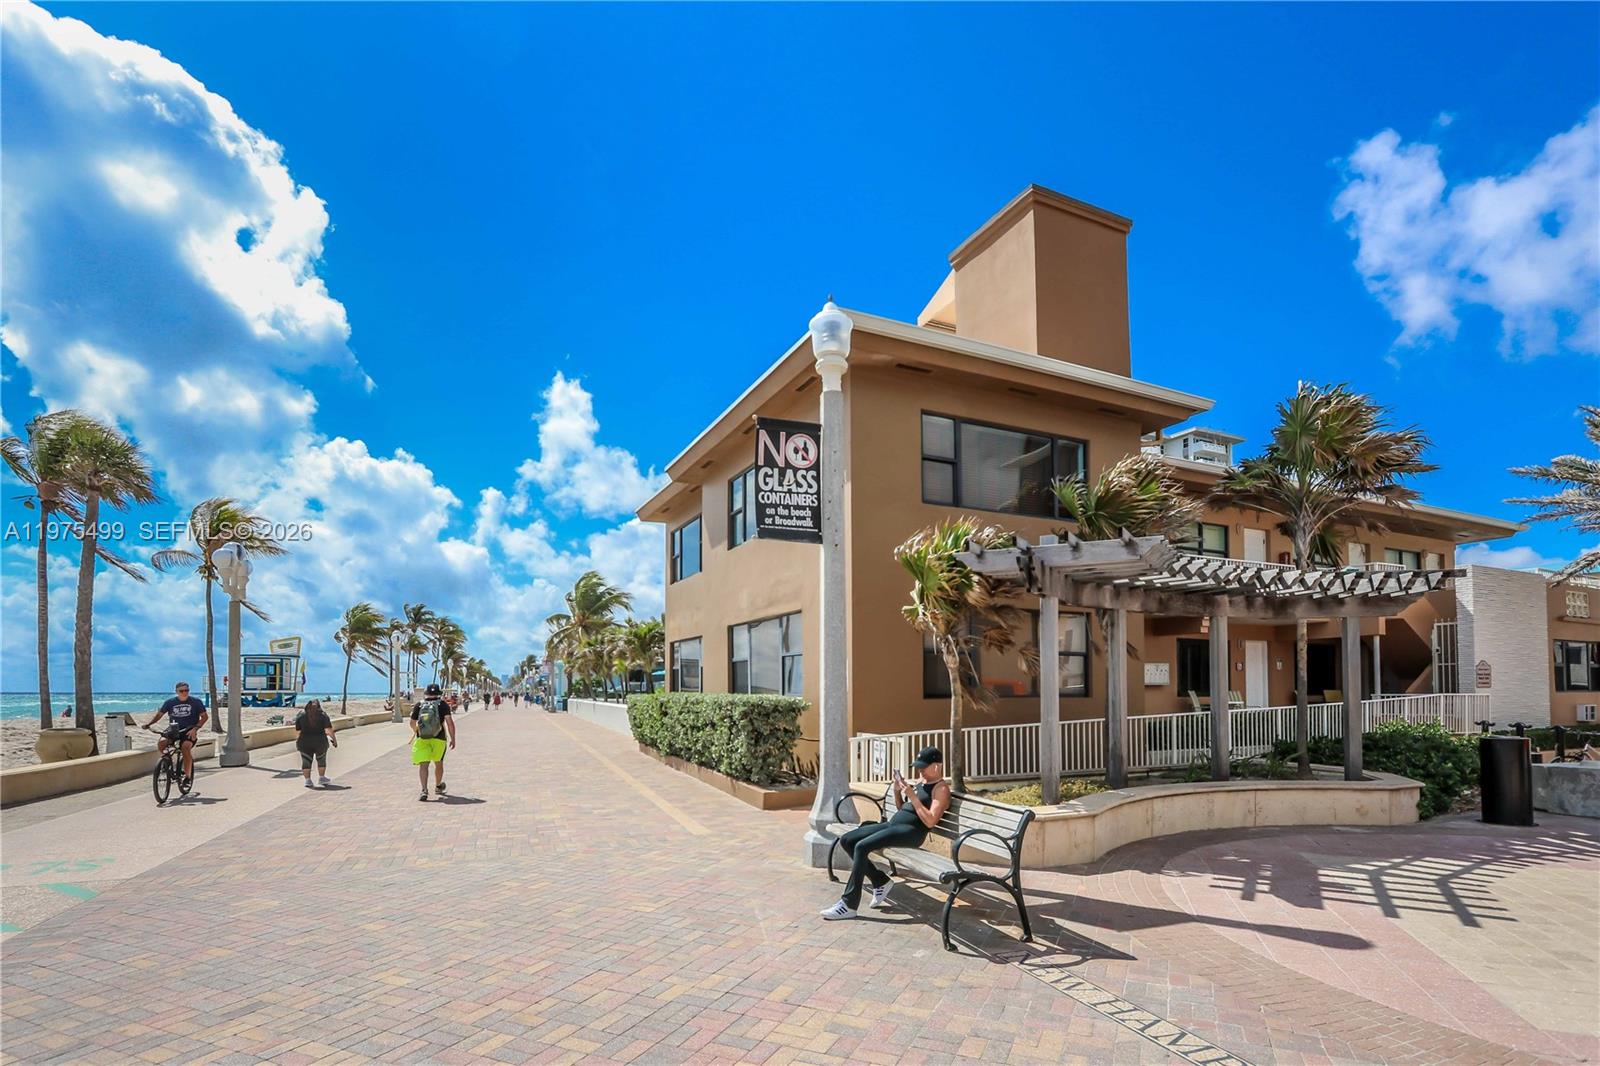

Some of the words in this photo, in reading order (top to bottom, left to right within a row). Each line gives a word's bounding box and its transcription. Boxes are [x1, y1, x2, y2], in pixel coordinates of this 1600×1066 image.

[758, 429, 818, 468] NO
[758, 467, 818, 493] GLASS
[759, 492, 818, 507] CONTAINERS
[766, 507, 775, 515] on
[777, 506, 789, 516] the
[790, 506, 812, 517] beach
[765, 517, 774, 525] or
[775, 515, 813, 528] Broadwalk
